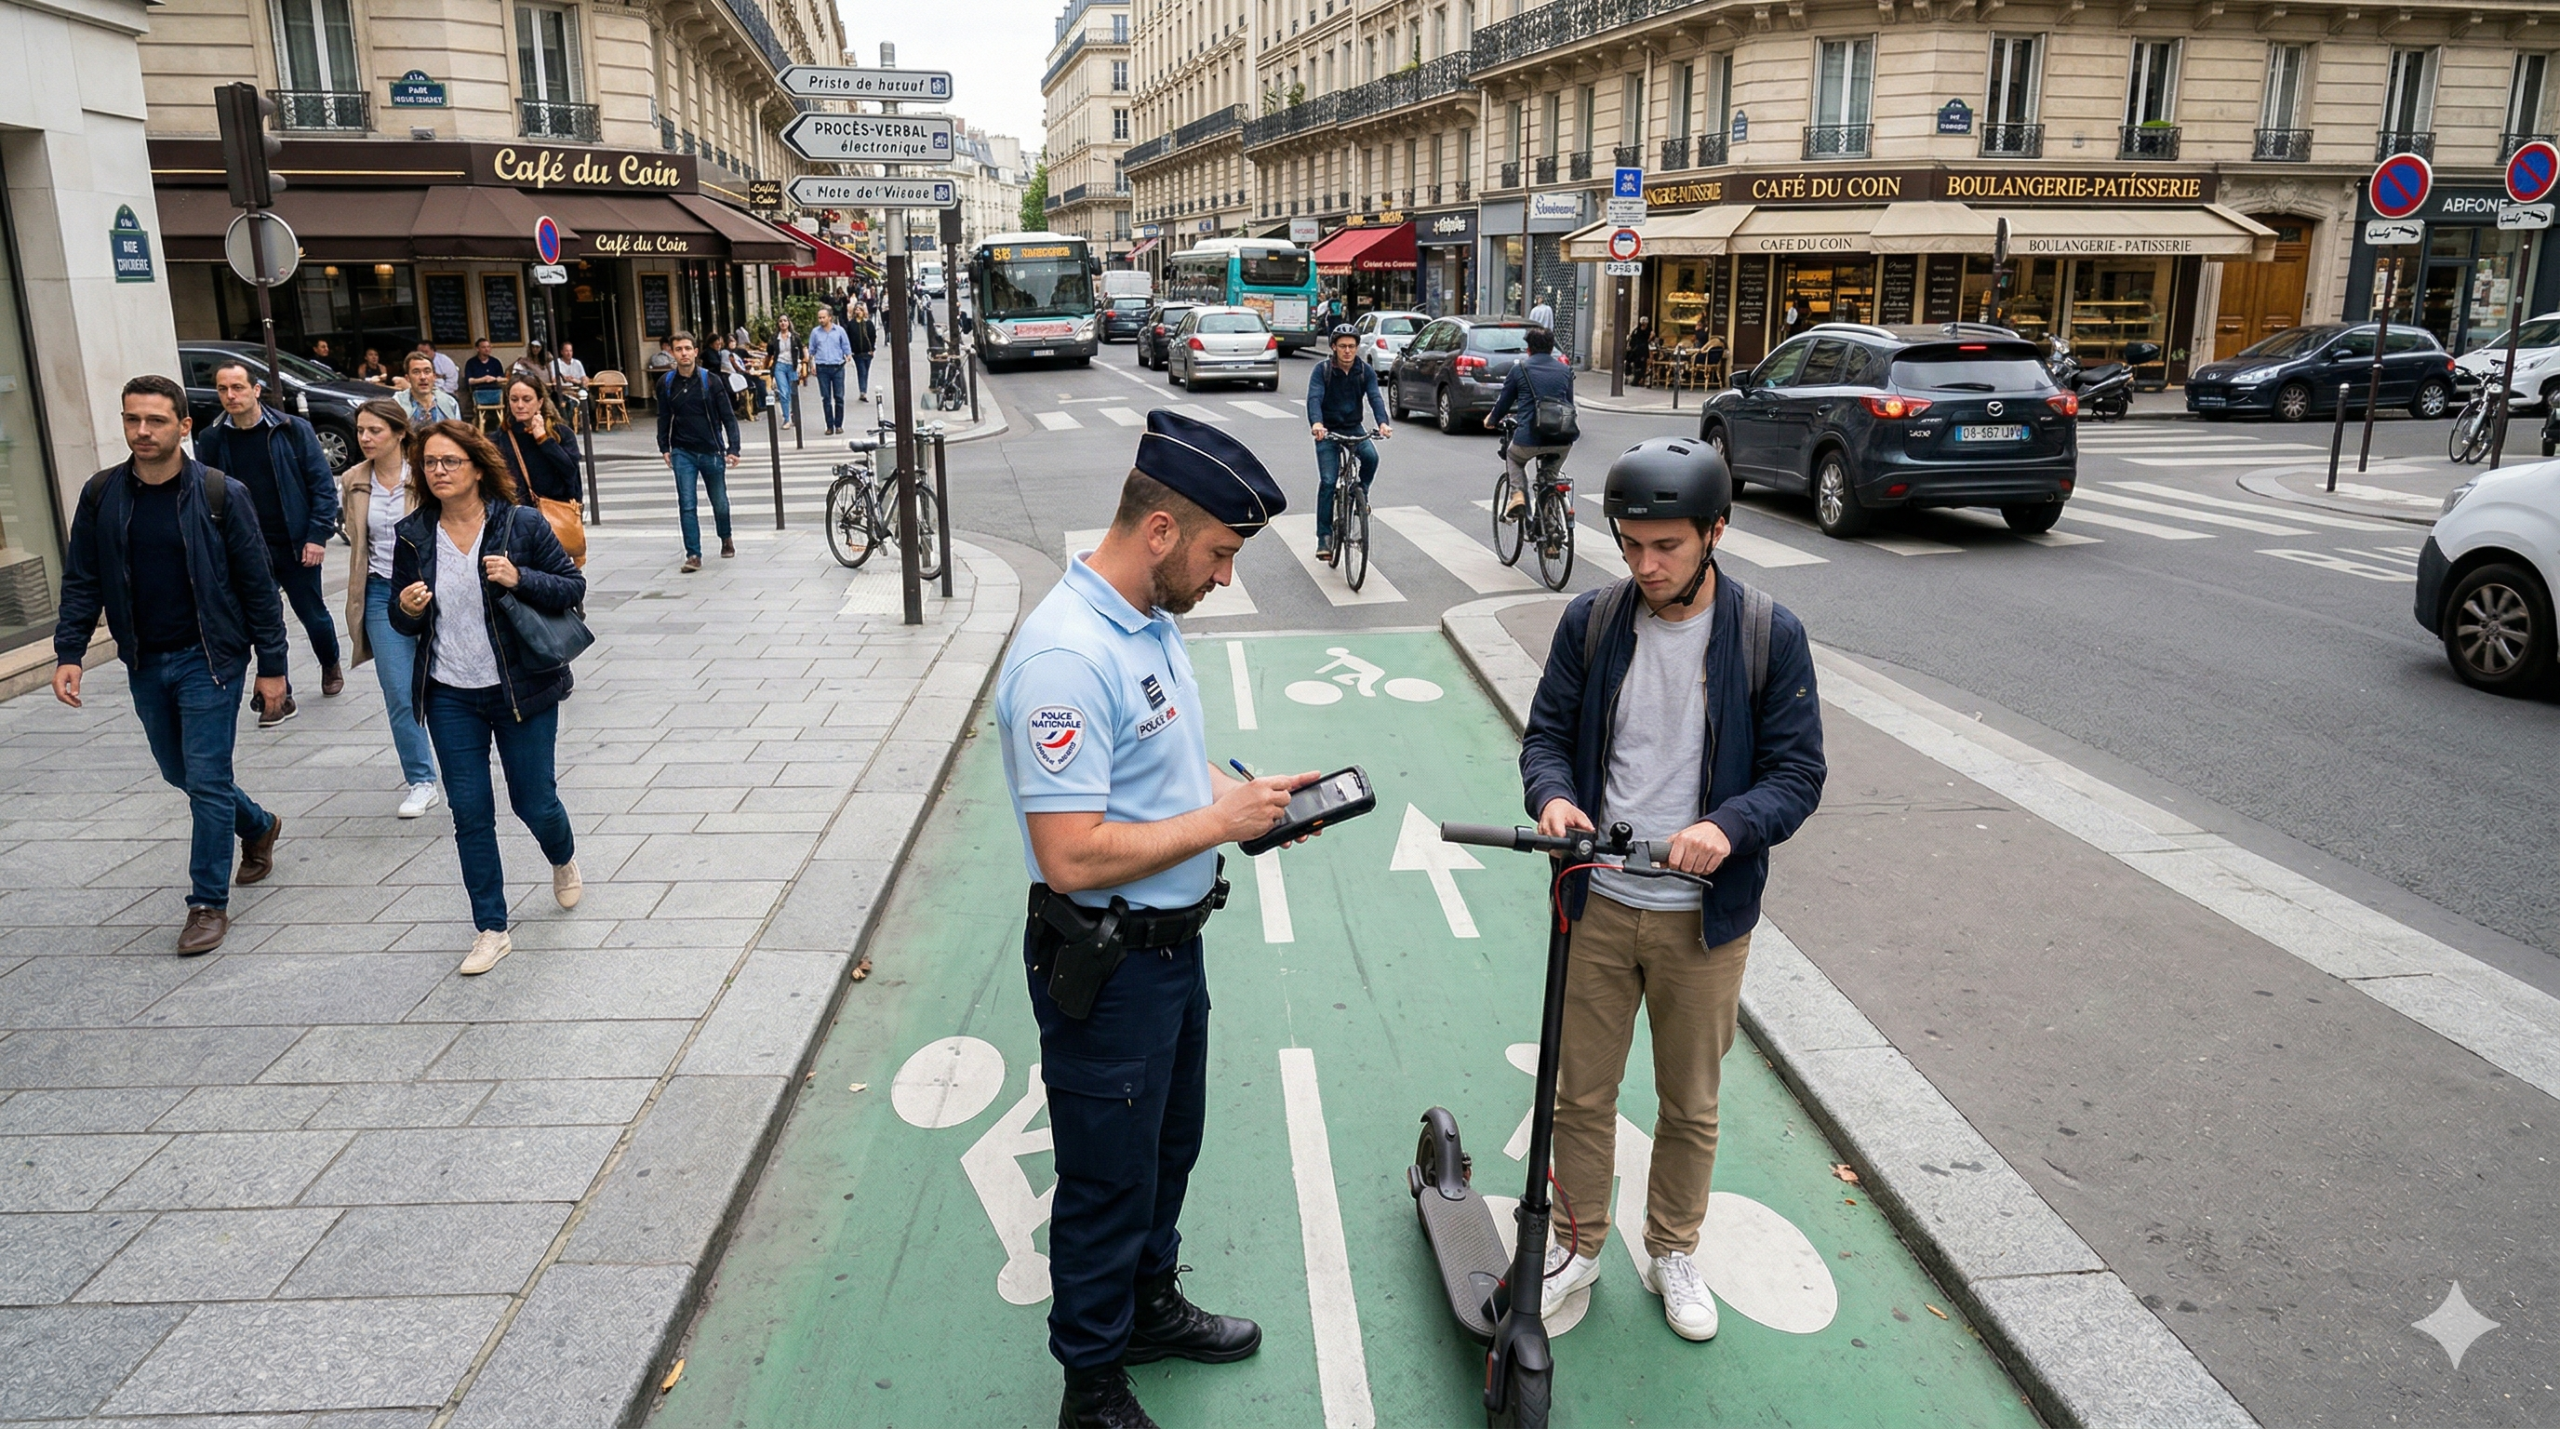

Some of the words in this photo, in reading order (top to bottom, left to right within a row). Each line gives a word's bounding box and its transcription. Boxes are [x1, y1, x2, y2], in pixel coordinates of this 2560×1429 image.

[856, 77, 872, 90] de
[814, 121, 927, 138] PROCÈS-VERBAL
[841, 139, 927, 156] électronique
[494, 147, 566, 189] Café
[572, 153, 612, 184] du
[619, 154, 681, 187] Coin
[1752, 174, 1806, 199] CAFÉ
[1810, 177, 1843, 197] DU
[1846, 176, 1902, 197] COIN
[595, 233, 631, 256] Café
[633, 234, 653, 251] du
[656, 235, 689, 252] Coin
[1760, 238, 1795, 250] CAFE
[1797, 238, 1818, 250] DU
[1819, 237, 1853, 250] COIN
[2029, 239, 2116, 252] BOULANGERIE
[2125, 239, 2192, 252] PATISSERIE
